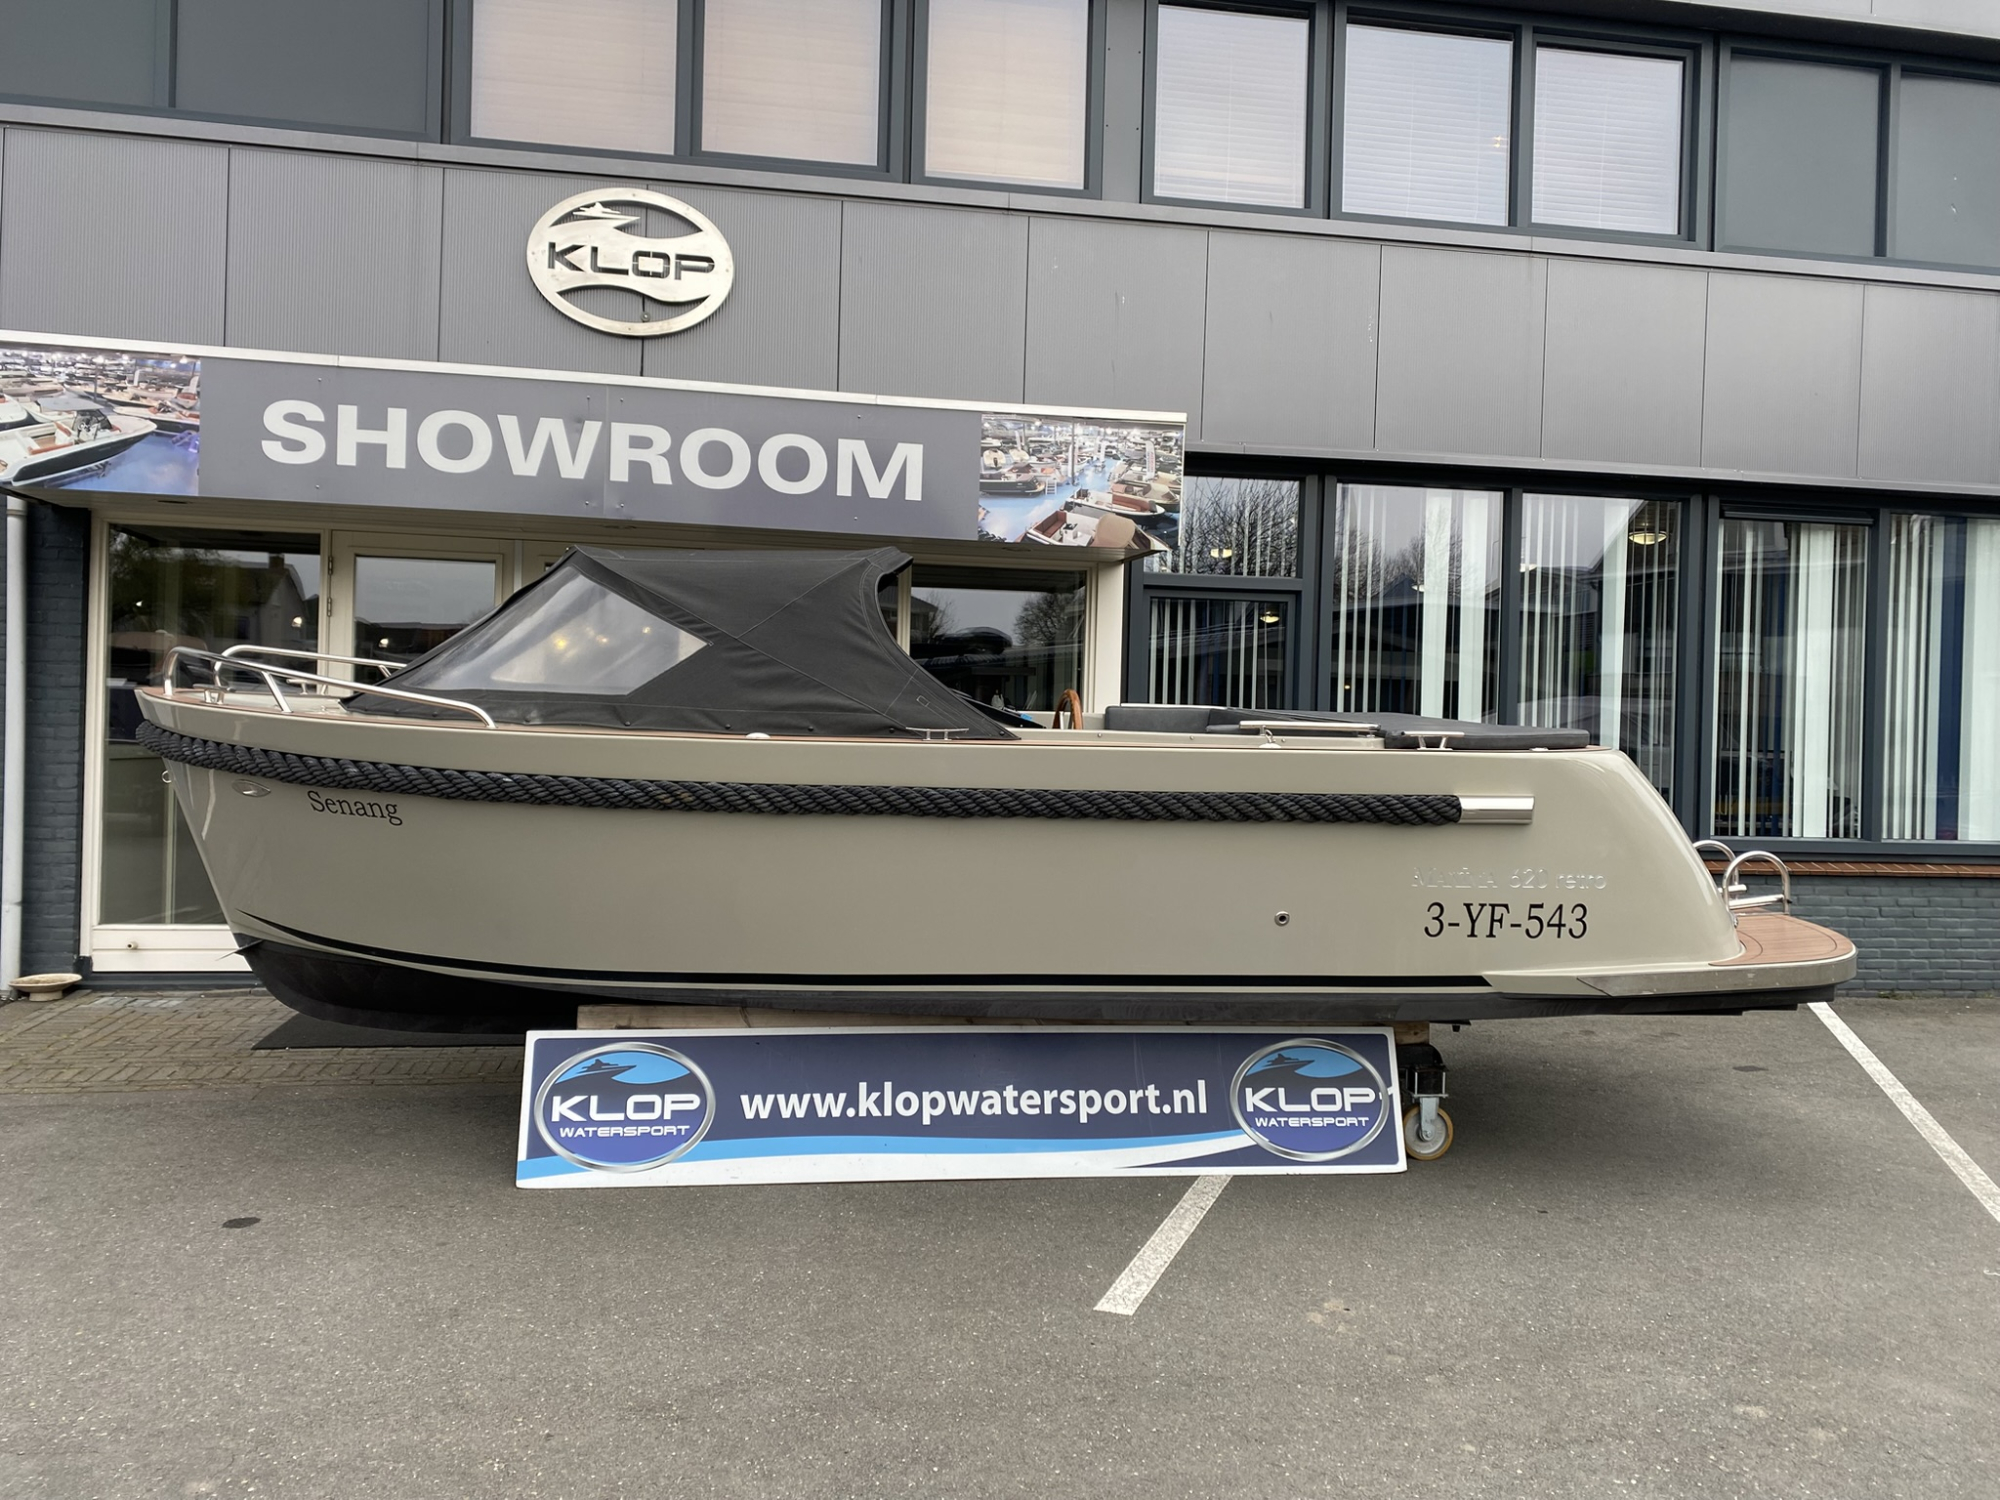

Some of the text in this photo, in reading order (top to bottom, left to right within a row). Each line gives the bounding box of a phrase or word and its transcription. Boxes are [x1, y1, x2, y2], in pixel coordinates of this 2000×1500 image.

[548, 241, 715, 280] KLOP
[261, 399, 924, 501] SHOWROOM
[307, 790, 403, 826] Senang
[1509, 868, 1548, 889] 620
[1555, 873, 1607, 889] retro
[1423, 901, 1588, 939] 3-YF-543
[551, 1093, 700, 1122] KLOP
[740, 1080, 1207, 1125] www.klopwatersport.nl
[1245, 1087, 1375, 1112] KLOP
[559, 1125, 690, 1138] WATERSPORT
[1255, 1116, 1369, 1128] WATERSPORT
